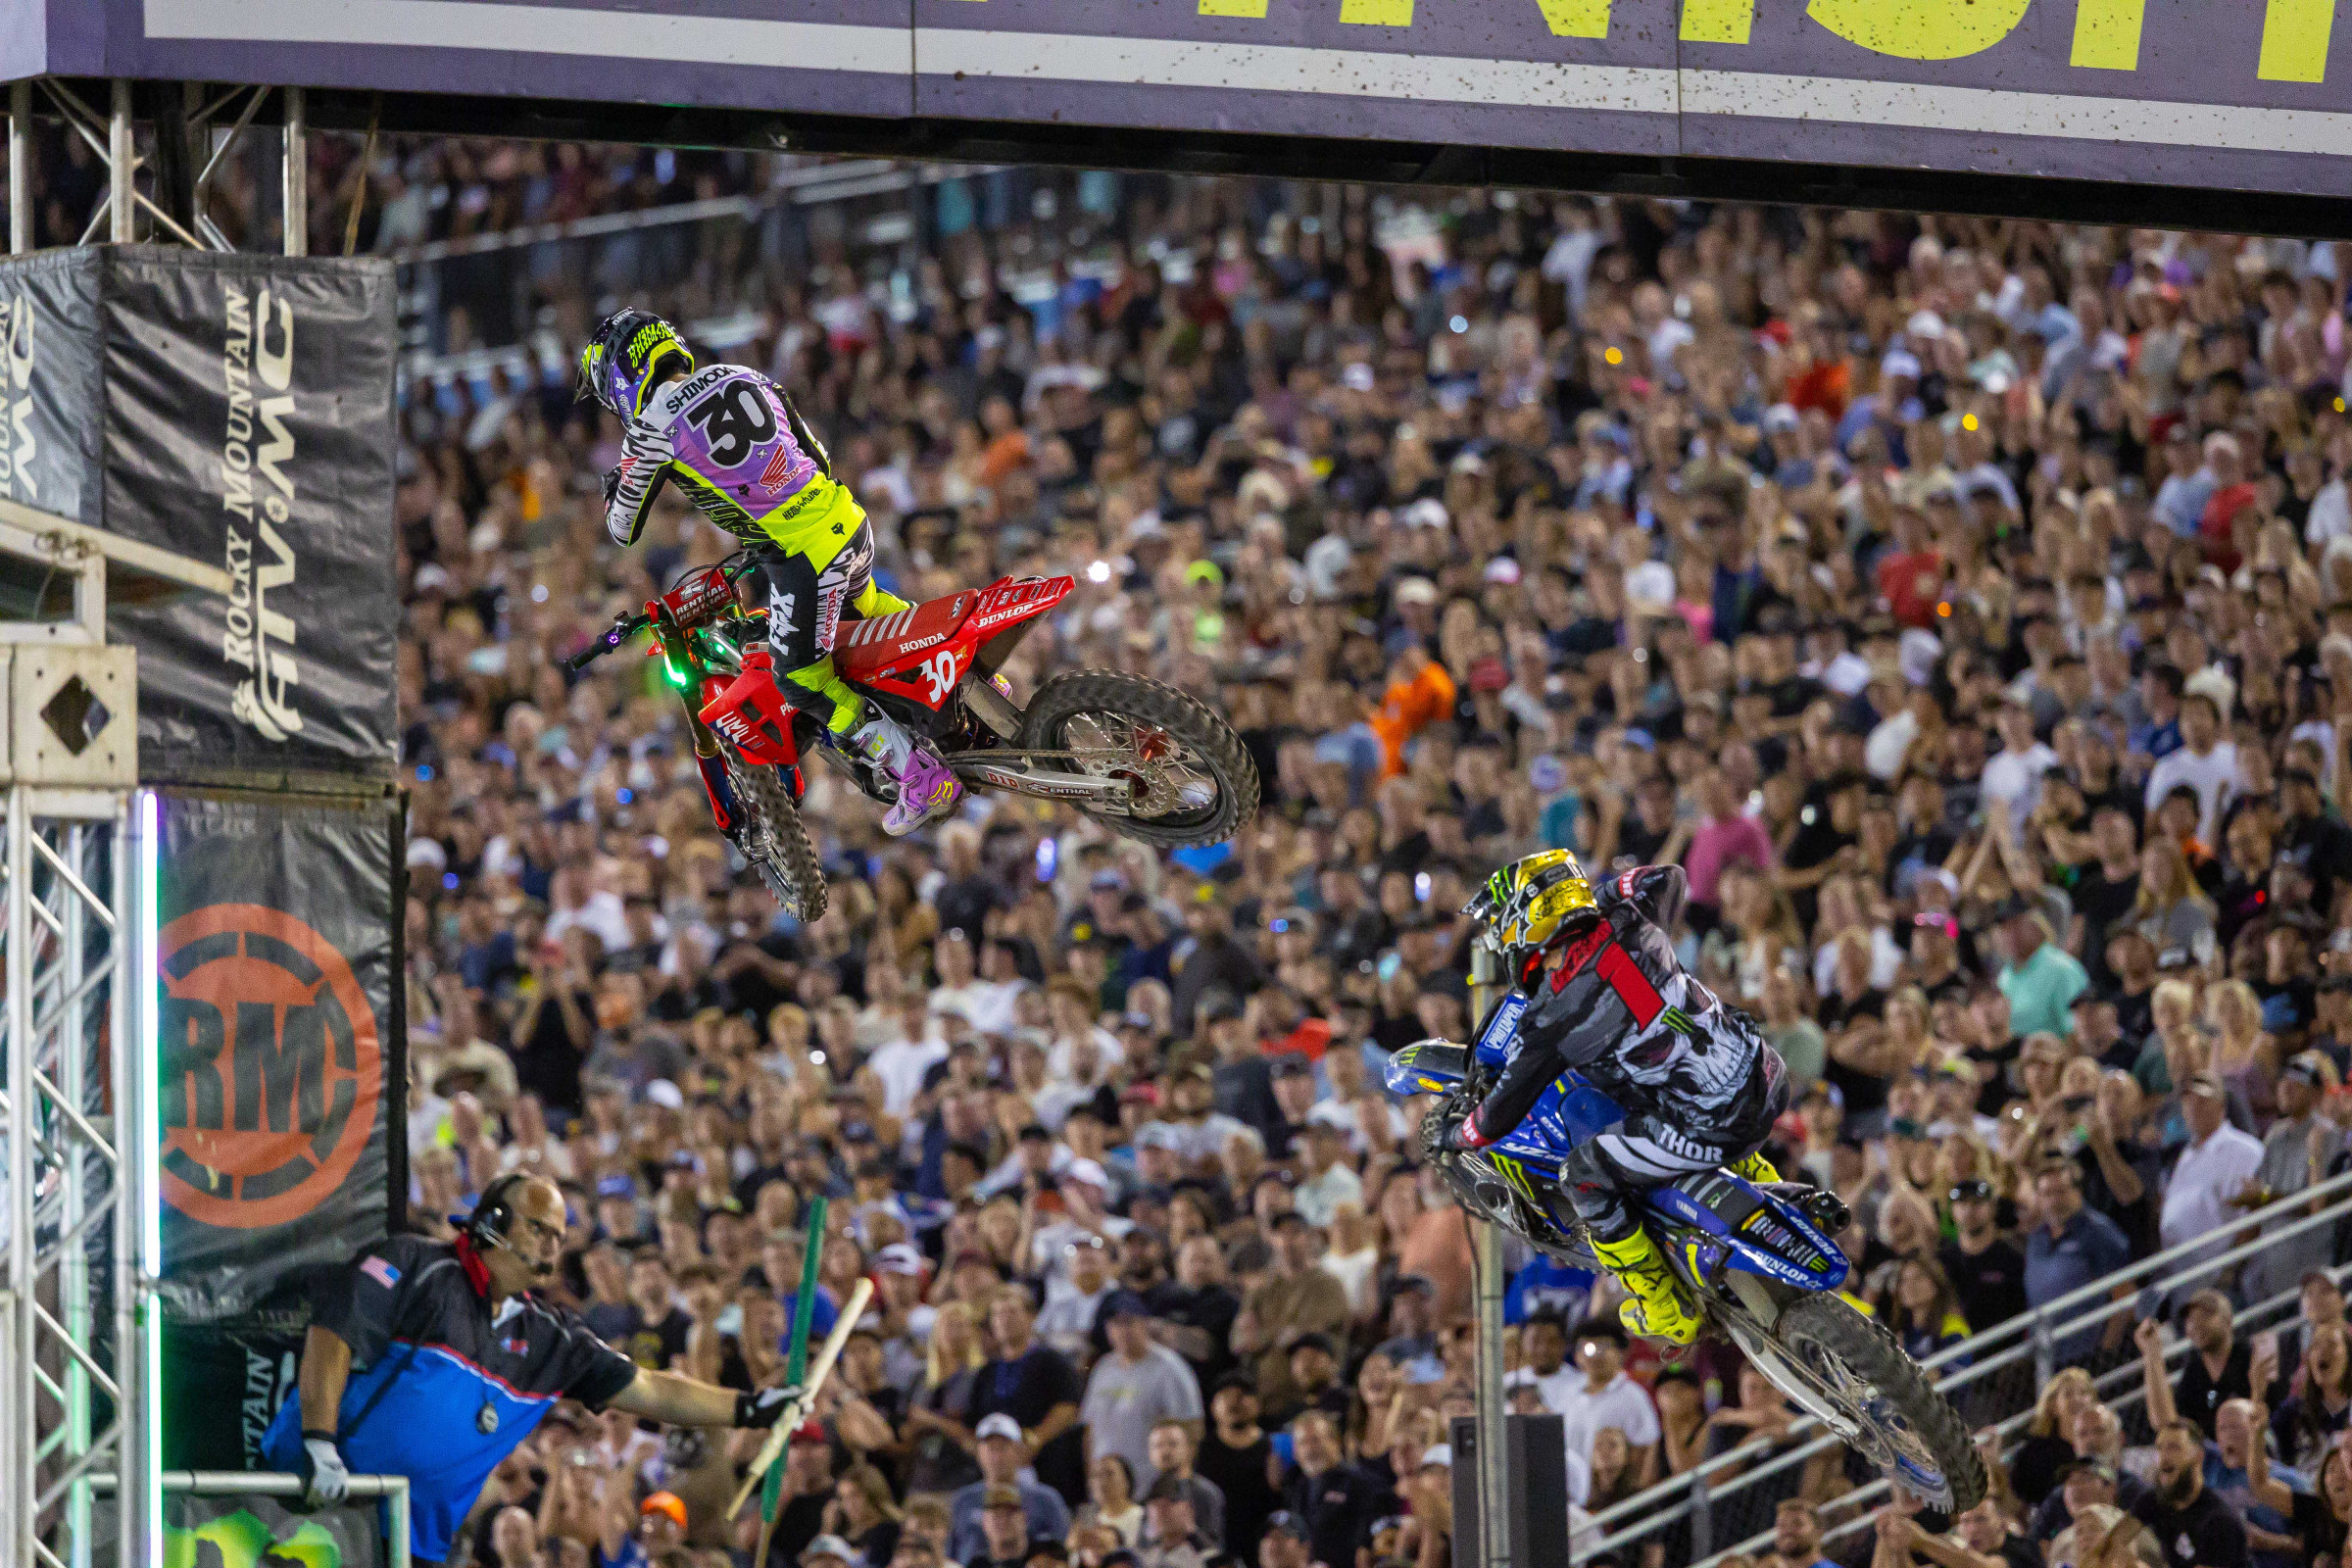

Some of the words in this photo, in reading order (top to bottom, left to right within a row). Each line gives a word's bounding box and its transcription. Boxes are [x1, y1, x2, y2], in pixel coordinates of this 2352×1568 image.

[223, 285, 254, 523] MOUNTAIN
[665, 365, 738, 415] SHIMODA
[684, 379, 778, 468] 30
[222, 525, 255, 672] ROCKY
[824, 587, 837, 637] HONDA
[977, 604, 1034, 628] DUNLOP
[899, 632, 948, 654] HONDA
[918, 650, 956, 704] 30
[1486, 1003, 1524, 1049] PROTAPER
[1659, 1123, 1723, 1162] THOR
[1754, 1250, 1810, 1282] DUNLOP
